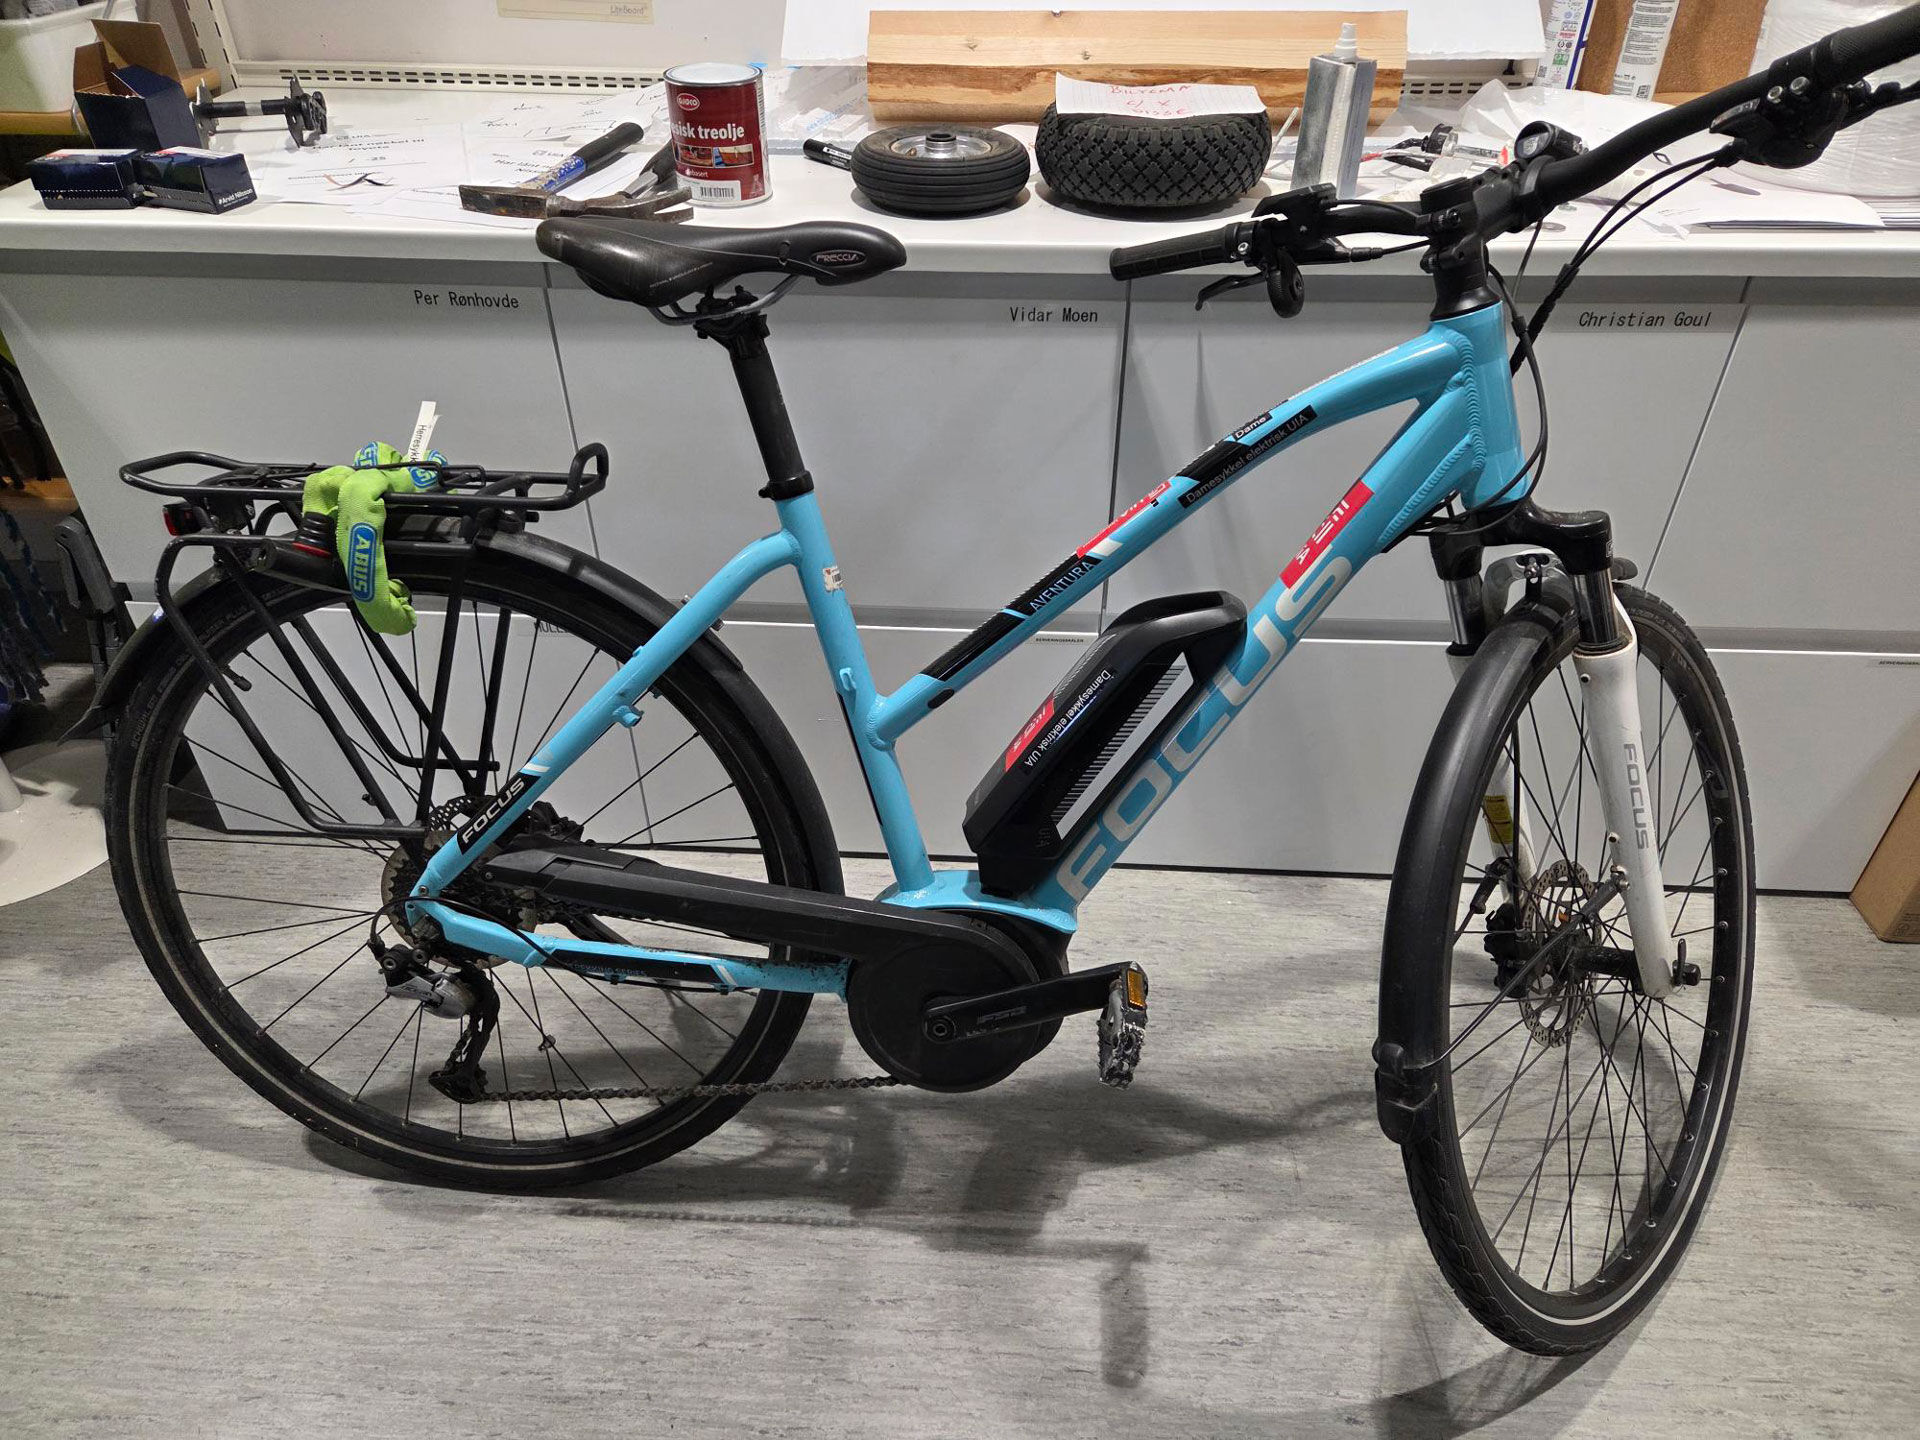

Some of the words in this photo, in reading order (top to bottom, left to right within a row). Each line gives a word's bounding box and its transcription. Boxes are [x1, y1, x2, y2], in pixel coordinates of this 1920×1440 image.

[697, 123, 745, 141] treolje
[414, 289, 439, 306] Per
[448, 291, 519, 309] Rønhovde
[1009, 306, 1053, 322] Vidar
[1062, 307, 1098, 322] Moen
[1578, 311, 1665, 327] Christian
[1673, 311, 1712, 327] Goul
[1186, 456, 1246, 504] Damesykkel
[1245, 428, 1290, 461] elektrisk
[353, 534, 371, 592] ABUS
[1029, 561, 1096, 612] AVENTURA
[1065, 669, 1112, 721] Damesykkel
[1037, 717, 1068, 752] elektrisk
[1056, 544, 1353, 902] FOCUS
[462, 777, 525, 844] FOCUS
[1623, 743, 1650, 850] FOCUS
